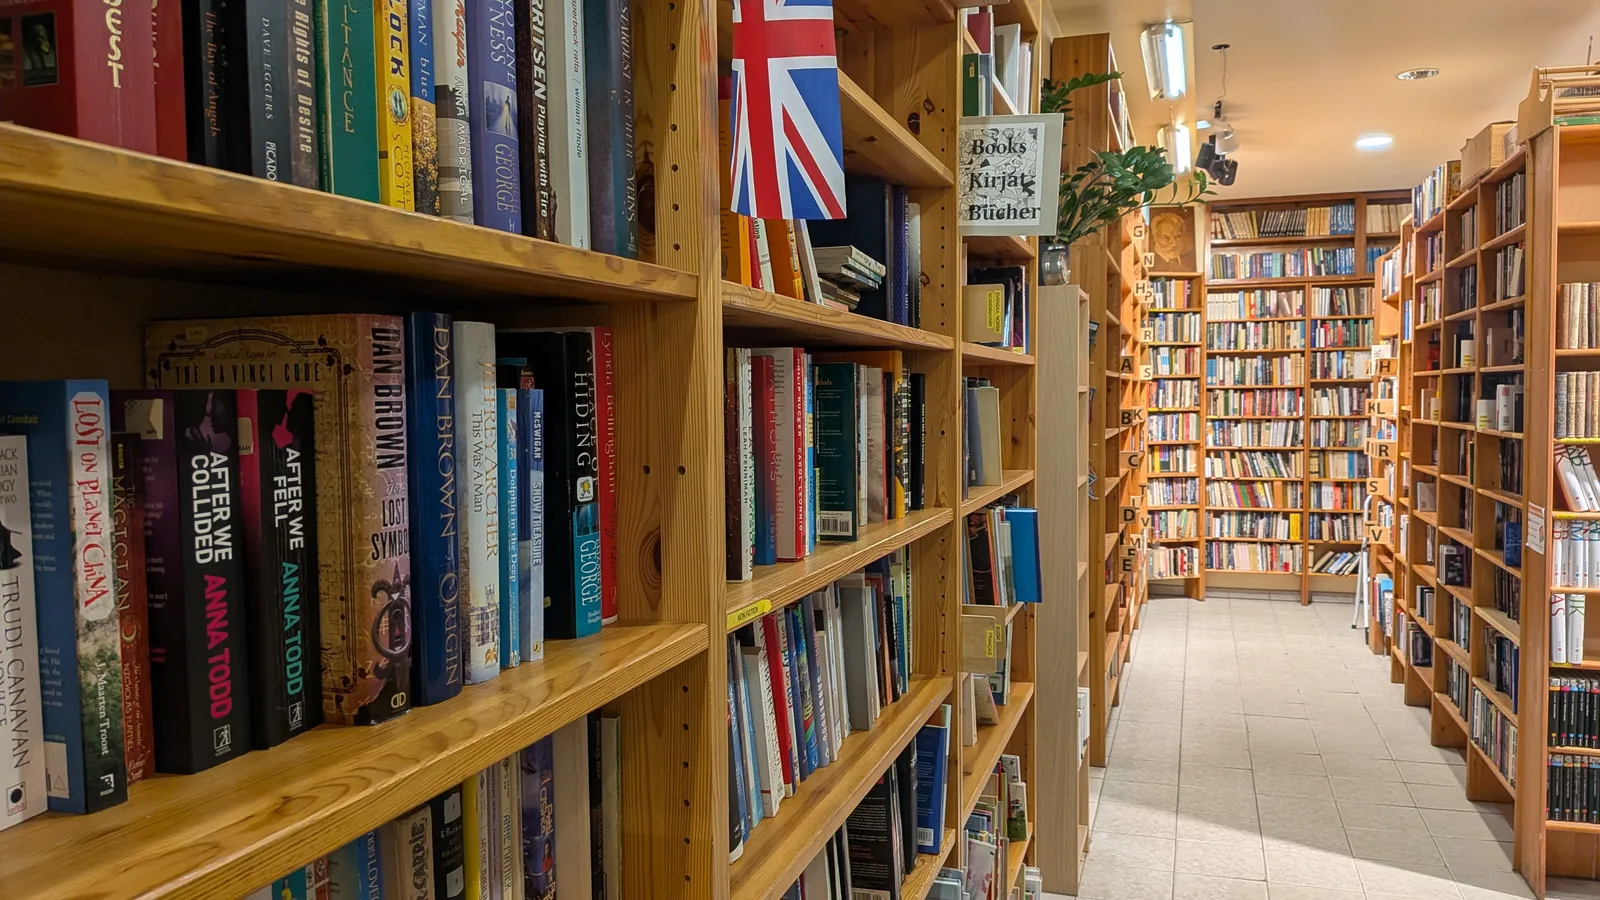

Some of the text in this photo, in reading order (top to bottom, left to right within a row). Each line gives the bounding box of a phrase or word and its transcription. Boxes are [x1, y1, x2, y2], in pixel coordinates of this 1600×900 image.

[505, 36, 516, 84] ONE
[620, 5, 631, 80] STARDUST
[204, 11, 221, 138] The Bay of Angels
[262, 17, 274, 120] DAVE EGGERS
[292, 10, 314, 153] Rights of Desire
[420, 57, 430, 98] blue
[454, 76, 466, 117] ANNA
[574, 88, 582, 125] william
[624, 89, 632, 106] IN
[537, 104, 547, 154] Playing
[575, 128, 583, 159] rhode
[625, 114, 634, 159] THEIR
[972, 137, 1027, 155] Books
[457, 122, 468, 205] MADRIGAL
[495, 144, 514, 213] GEORGE
[539, 159, 549, 187] with
[968, 172, 1026, 193] Kirjat
[540, 190, 549, 218] Fire
[968, 203, 1041, 221] Bücher
[1133, 225, 1143, 238] G
[1144, 255, 1153, 266] N
[1135, 282, 1145, 294] H
[1145, 291, 1153, 302] P
[1144, 330, 1152, 340] R
[174, 362, 321, 385] THE DA VINCI CODE
[586, 349, 593, 362] A
[1121, 358, 1133, 372] A
[1144, 367, 1151, 378] S
[1379, 360, 1391, 373] H
[371, 327, 406, 469] DAN BROWN
[601, 332, 617, 493] Lynda Bellingham
[1133, 409, 1143, 421] K
[1377, 402, 1386, 415] L
[73, 400, 105, 450] LOST
[434, 326, 456, 538] DAN BROWN
[532, 411, 542, 460] McSWIGAN
[574, 372, 591, 467] HIDING
[1121, 411, 1132, 425] B
[472, 410, 484, 513] This Was A Man
[477, 361, 499, 561] JEFFREY ARCHER
[1128, 455, 1138, 467] C
[1379, 444, 1390, 457] R
[126, 485, 136, 508] THE
[273, 476, 288, 528] FELL
[285, 447, 305, 551] AFTER WE
[1139, 484, 1147, 496] T
[1369, 480, 1379, 493] S
[191, 454, 211, 565] COLLIDED
[210, 452, 233, 563] AFTER WE
[382, 497, 406, 528] LOST
[508, 468, 518, 583] Dolphin in the Deep
[532, 482, 543, 568] SNOW TREASURE
[1124, 508, 1136, 522] D
[1141, 517, 1150, 527] V
[111, 474, 131, 611] MAGICIAN
[371, 528, 410, 561] SYMBO
[1371, 529, 1383, 542] V
[579, 540, 600, 608] GEORGE
[1122, 558, 1132, 572] E
[204, 574, 229, 650] ANNA
[282, 561, 304, 696] ANNA TODD
[440, 572, 460, 686] ORIGIN
[737, 606, 760, 622] NON FICTION
[2, 576, 30, 769] TRUDI CANAVAN
[207, 648, 233, 720] TODD
[95, 662, 111, 756] J. Maarten Troost
[123, 662, 135, 753] NICHOLAS FLAMEL
[9, 803, 27, 814] orbit
[503, 814, 511, 845] ANNE
